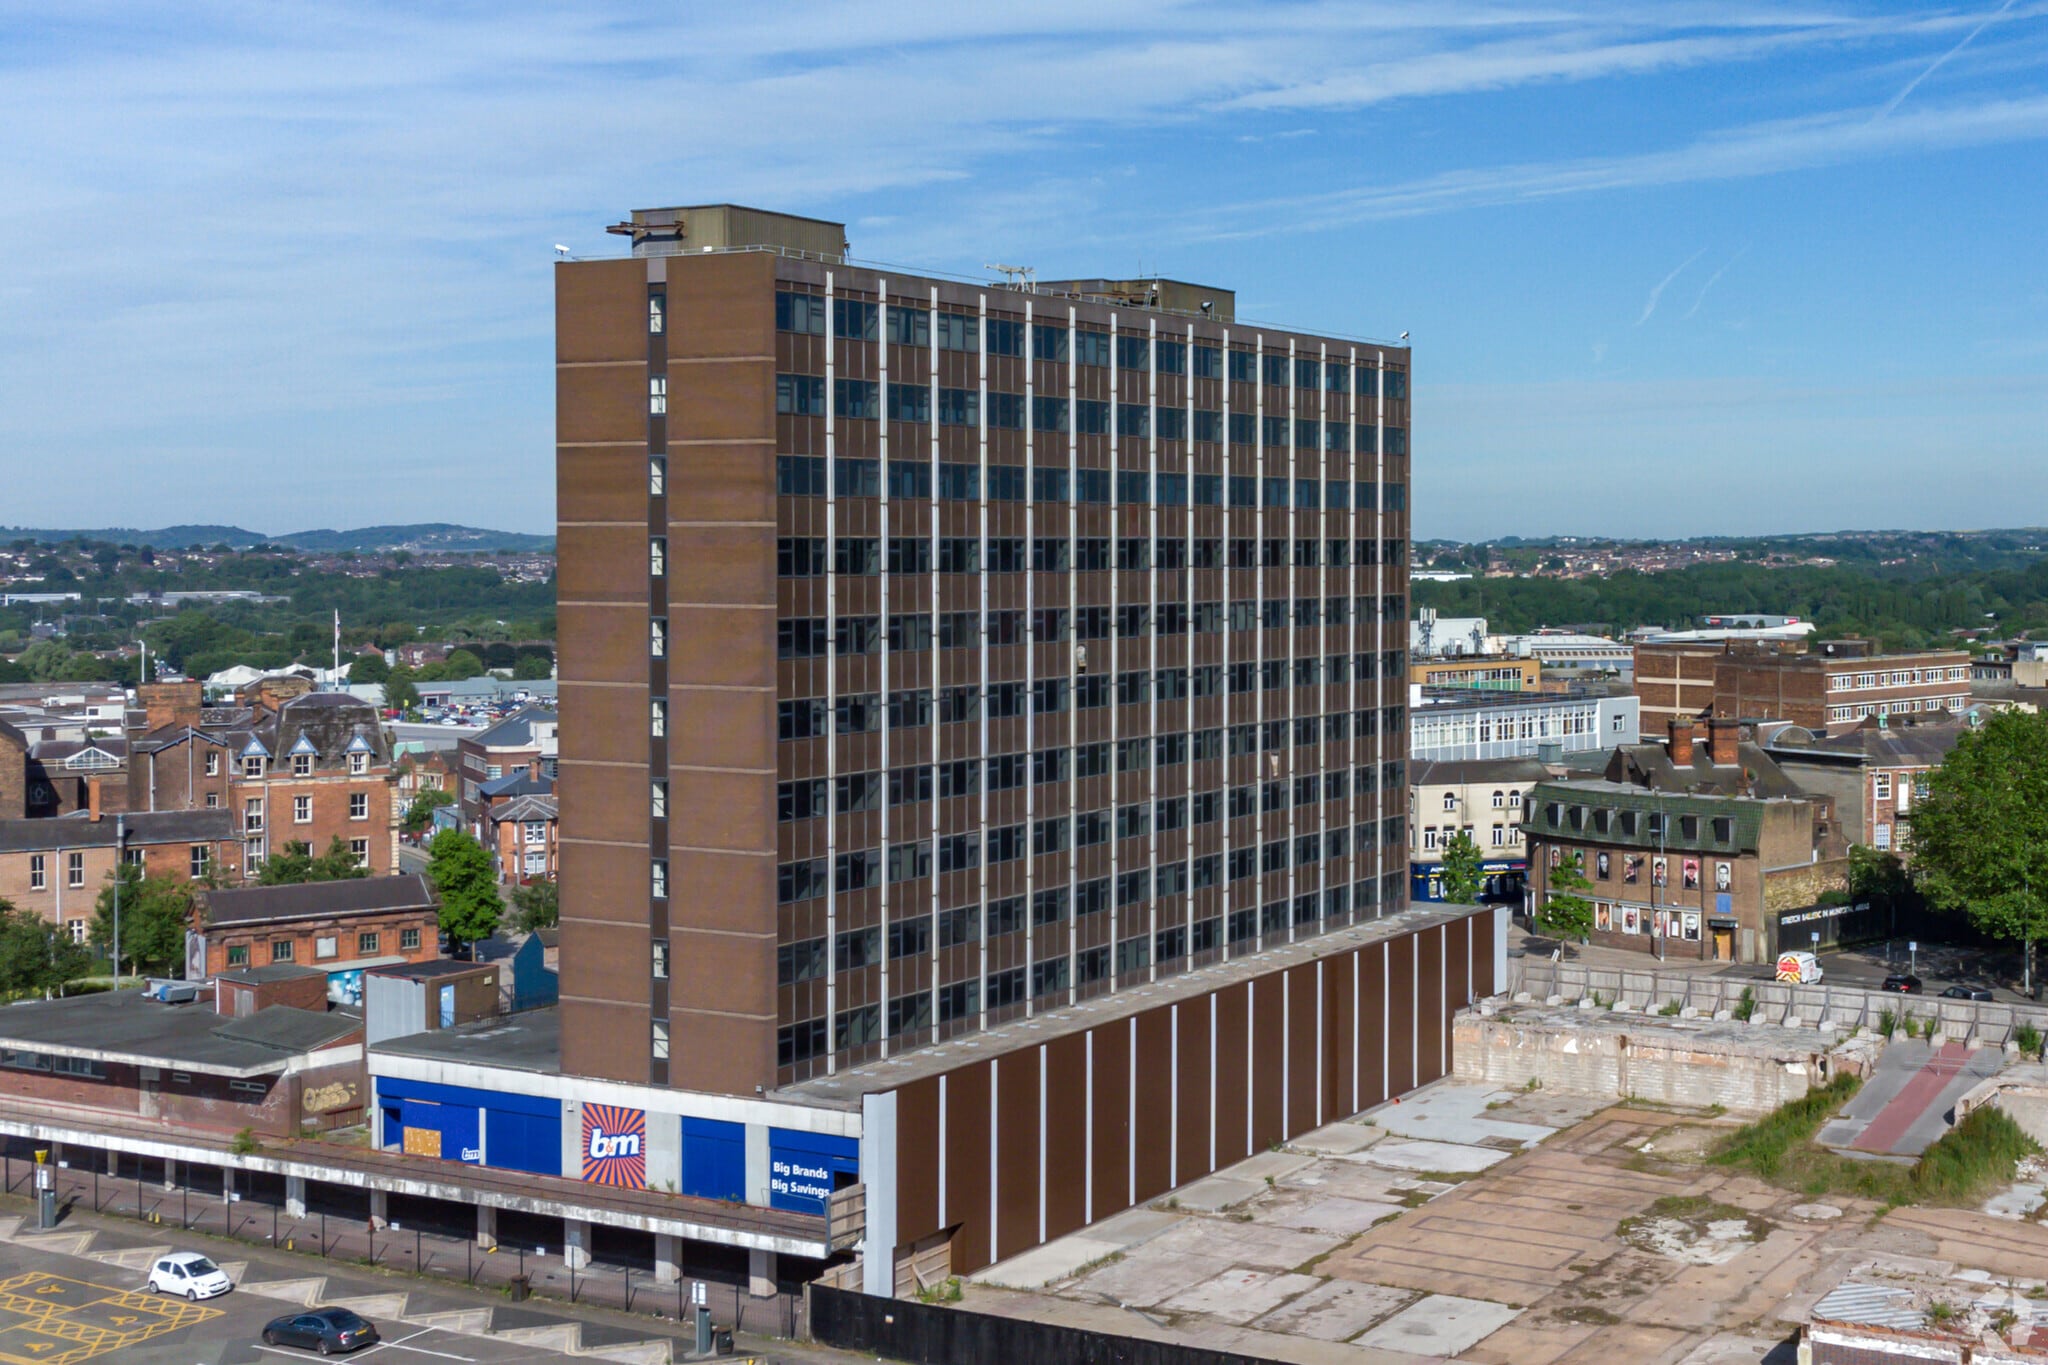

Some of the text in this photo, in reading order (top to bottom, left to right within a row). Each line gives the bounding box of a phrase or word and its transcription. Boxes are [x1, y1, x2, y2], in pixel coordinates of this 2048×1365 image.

[590, 1128, 640, 1158] b&m
[773, 1162, 828, 1179] Big Brands
[771, 1179, 829, 1198] Big Savings
